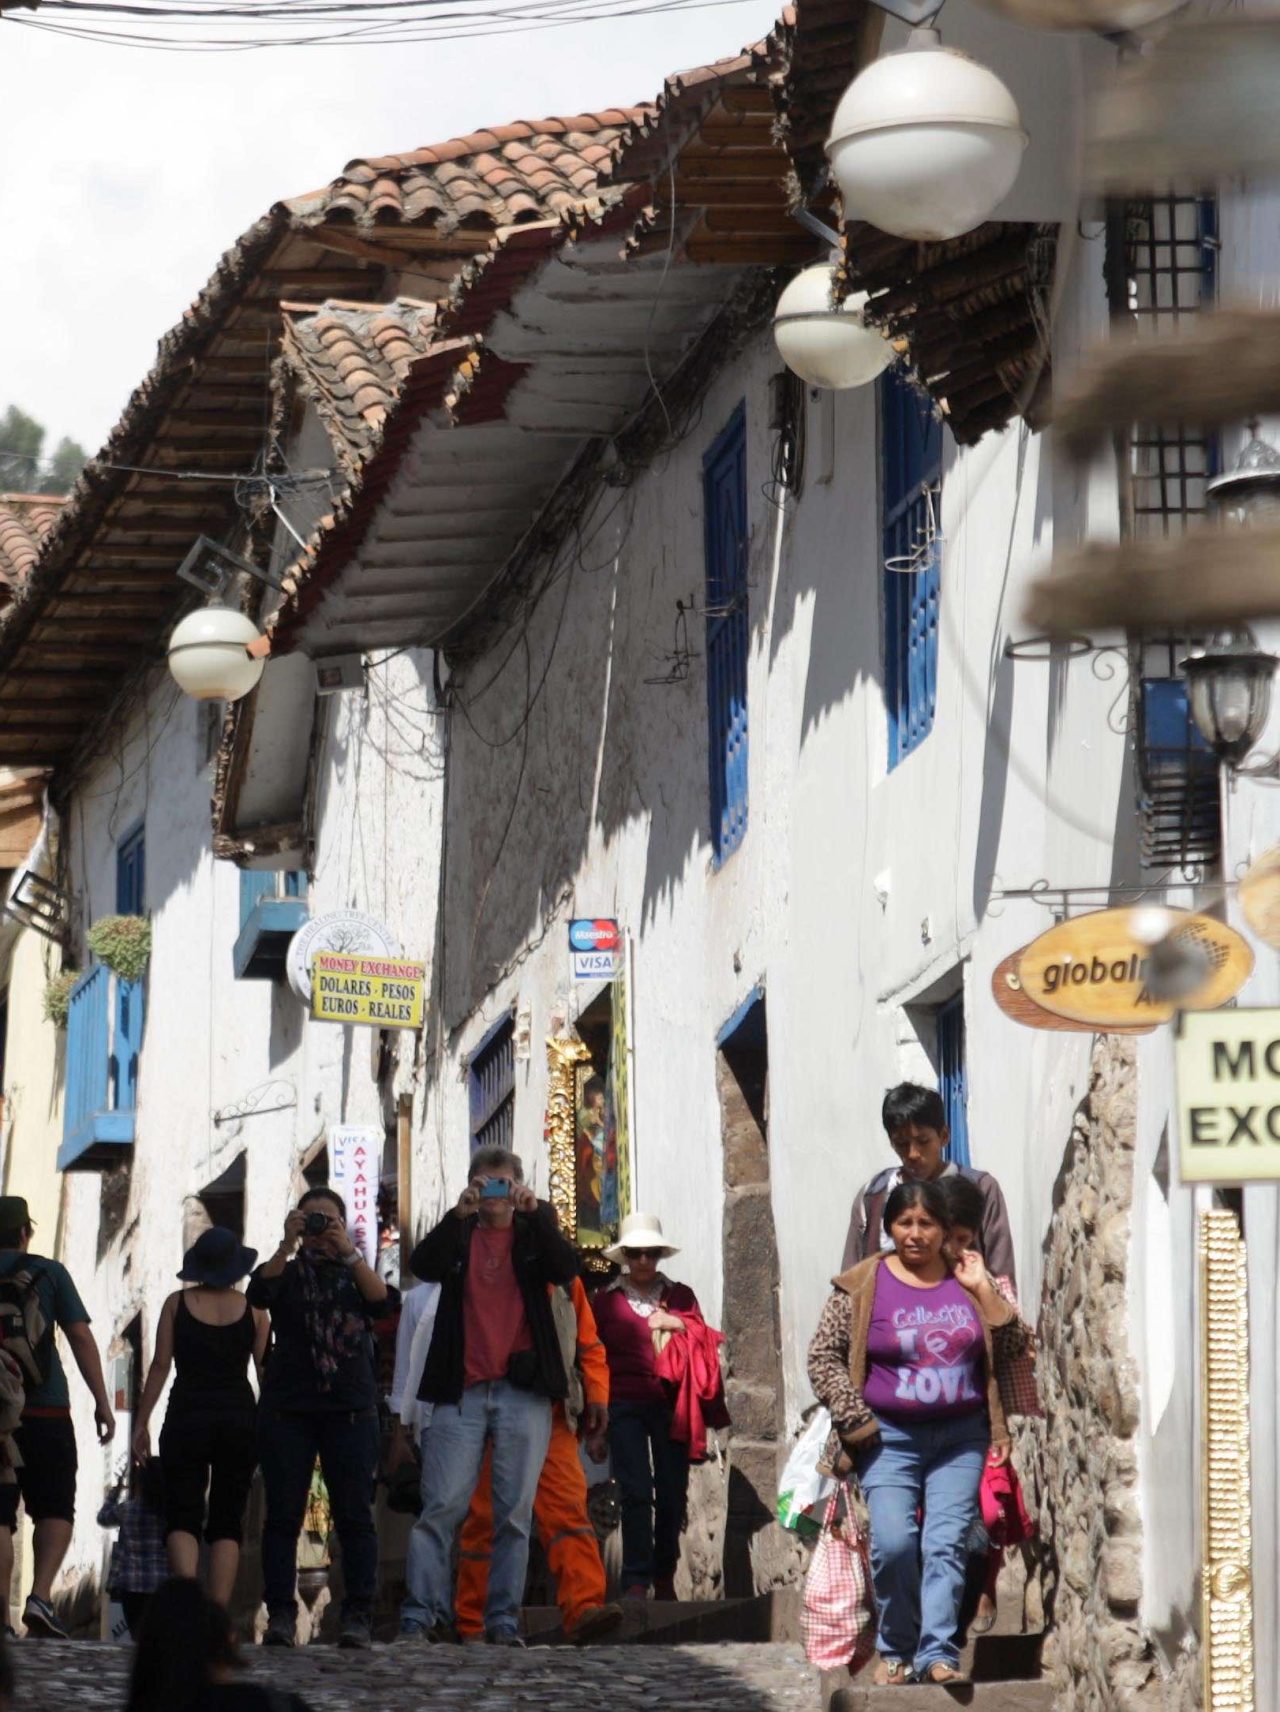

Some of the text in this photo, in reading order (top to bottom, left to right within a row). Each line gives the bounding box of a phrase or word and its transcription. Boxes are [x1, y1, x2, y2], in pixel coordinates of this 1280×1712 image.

[320, 957, 420, 978] MONEY EXCHANGE
[580, 956, 612, 969] VISA
[320, 976, 371, 996] DOLARES
[381, 982, 416, 1002] PESOS
[322, 996, 359, 1016] EUROS
[368, 1001, 412, 1021] REALES
